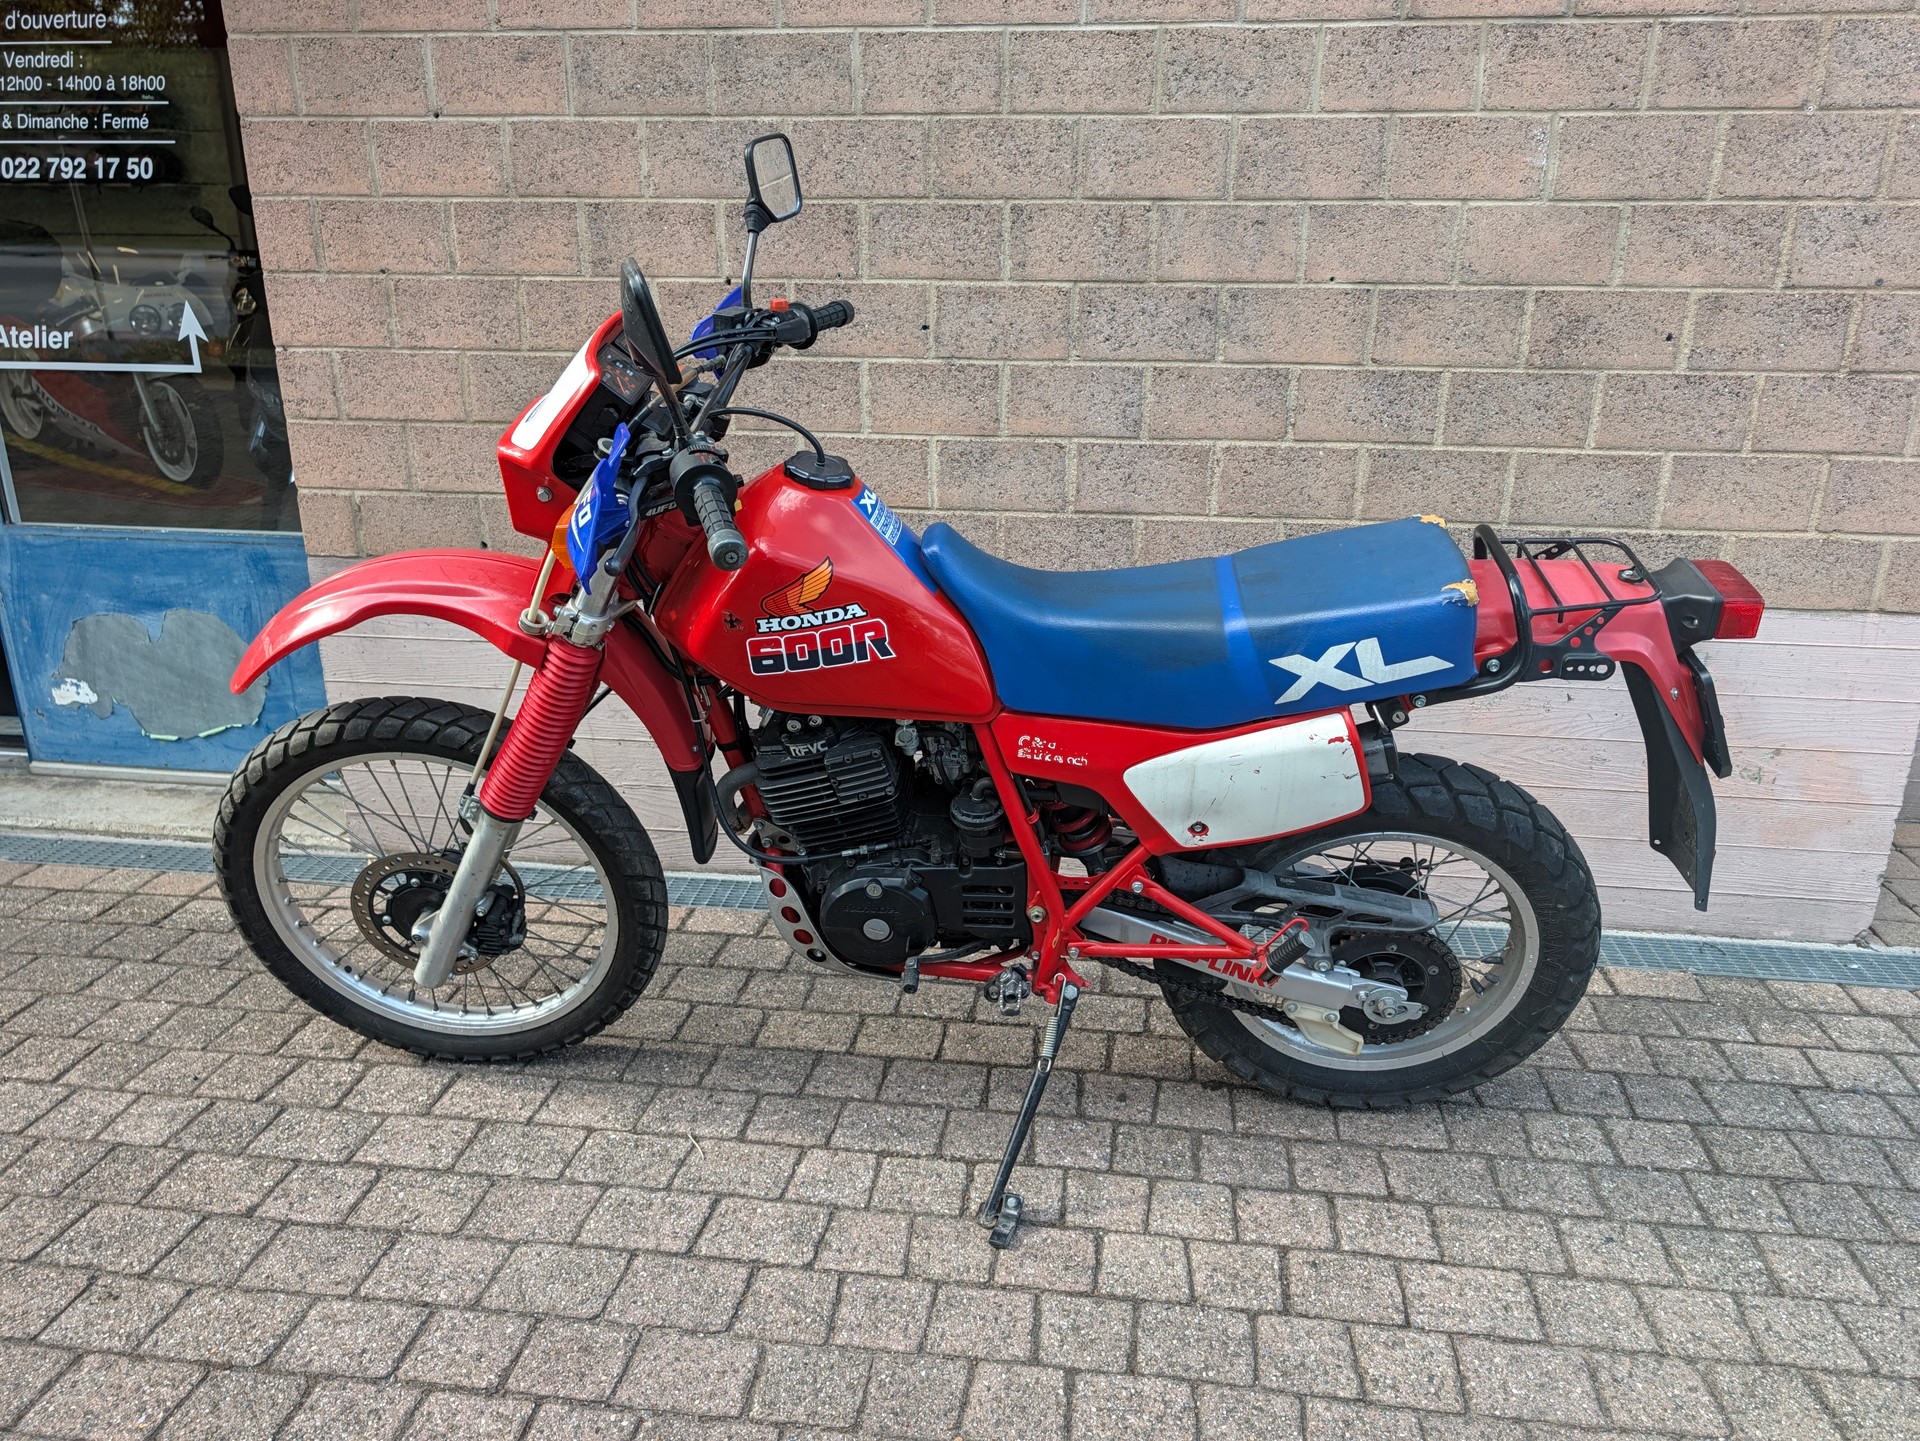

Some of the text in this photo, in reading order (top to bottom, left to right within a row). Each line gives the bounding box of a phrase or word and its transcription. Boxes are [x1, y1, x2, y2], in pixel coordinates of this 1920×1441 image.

[5, 10, 107, 29] d'ouverture
[3, 51, 74, 68] Vendredi
[0, 75, 42, 91] 12h00
[57, 75, 102, 91] 14h00
[106, 74, 116, 91] à
[120, 75, 166, 91] 18h00
[2, 115, 12, 129] &
[17, 114, 89, 130] Dimanche
[102, 113, 149, 130] Fermé
[1, 157, 153, 180] 022 792 17 50
[0, 324, 74, 350] Atelier
[756, 603, 868, 634] HONDA
[746, 618, 897, 676] 600R
[1268, 636, 1456, 706] XL
[789, 740, 829, 757] RFVC
